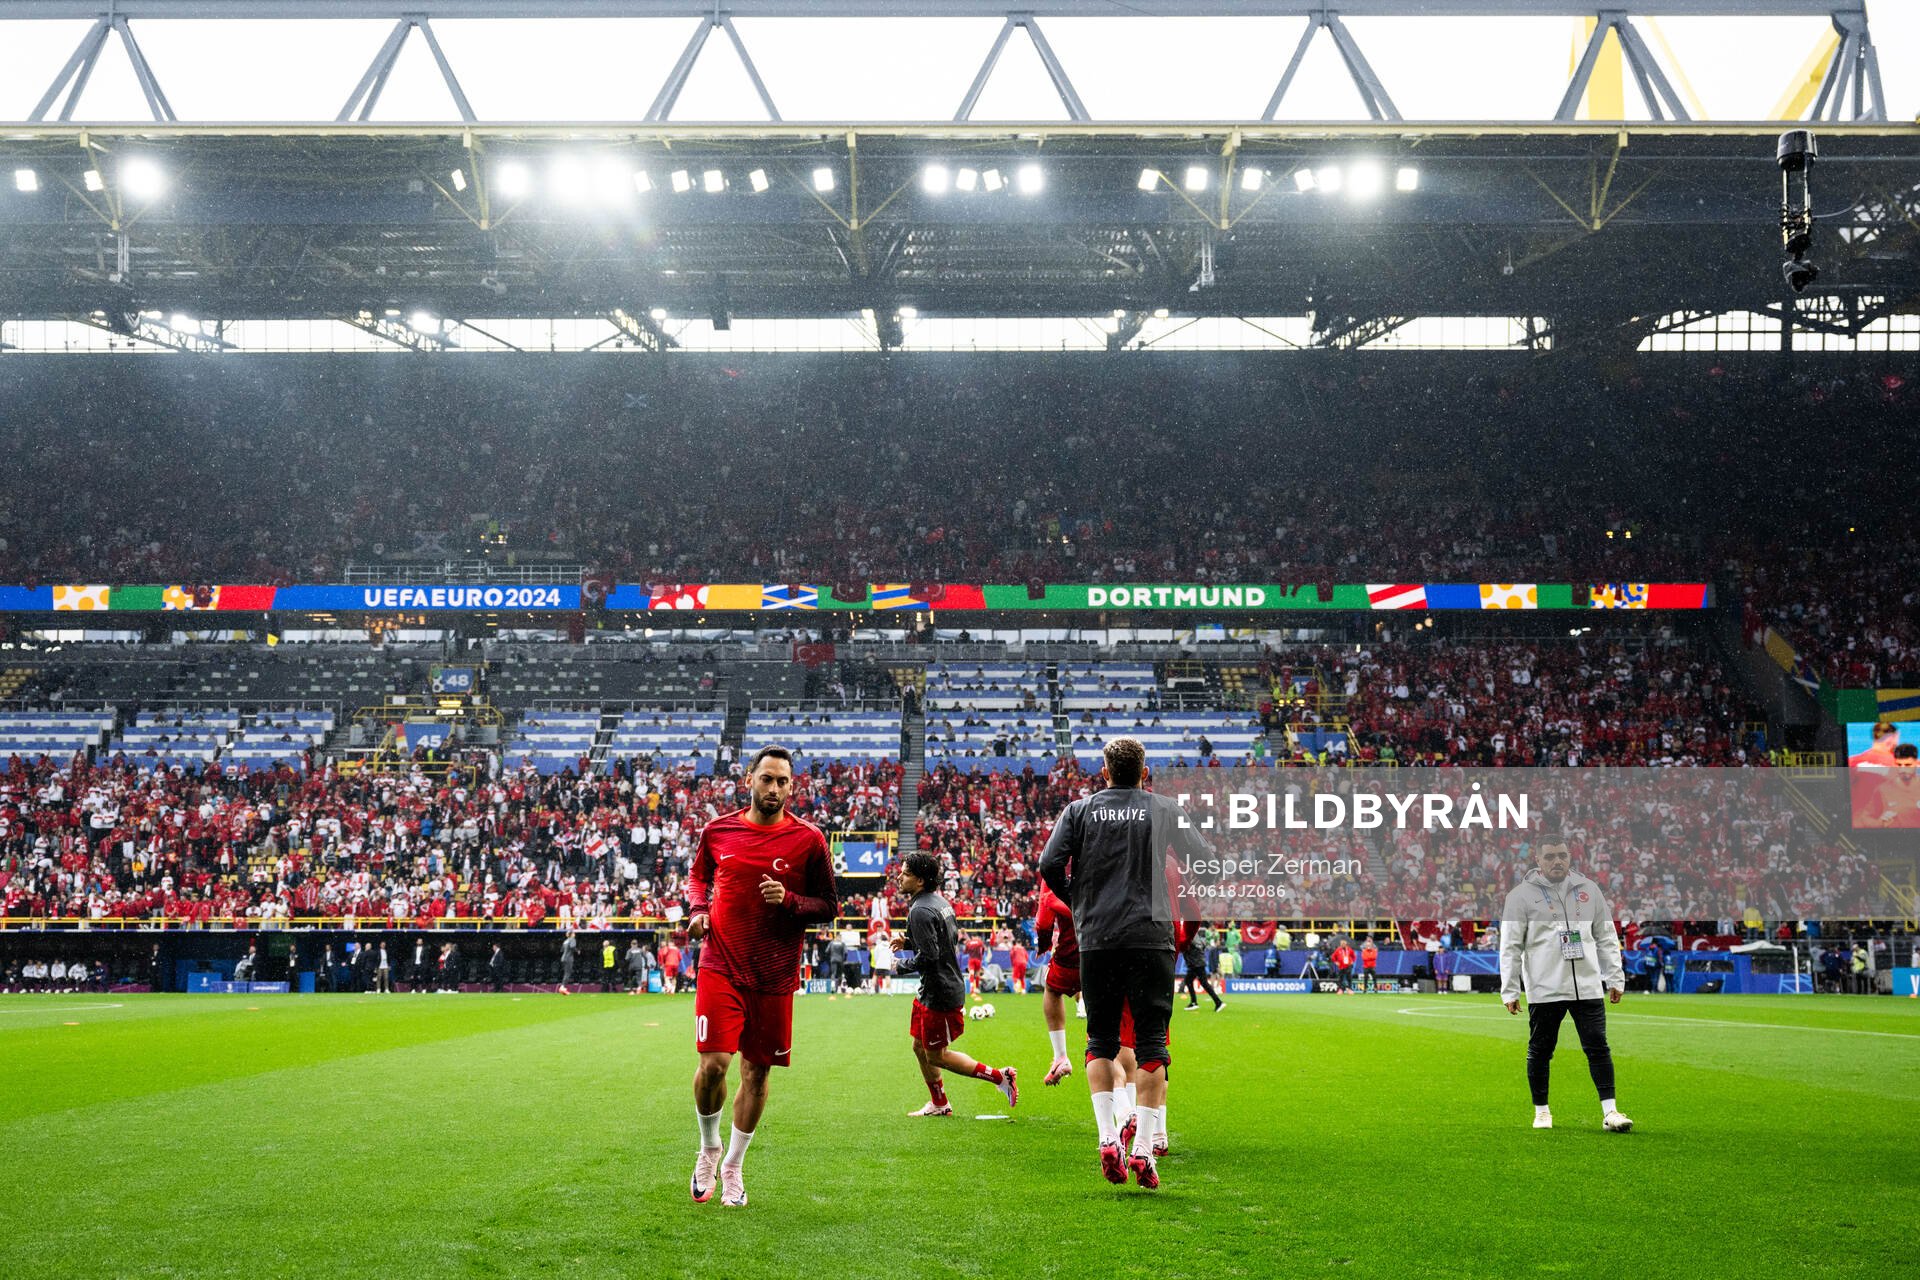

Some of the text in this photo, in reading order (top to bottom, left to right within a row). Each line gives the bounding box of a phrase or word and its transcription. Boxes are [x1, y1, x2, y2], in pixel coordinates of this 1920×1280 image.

[1088, 587, 1266, 607] DORTMUND
[446, 674, 469, 687] 48
[417, 735, 441, 748] 45
[1091, 806, 1146, 823] TÜRKİYE
[858, 850, 884, 866] 41
